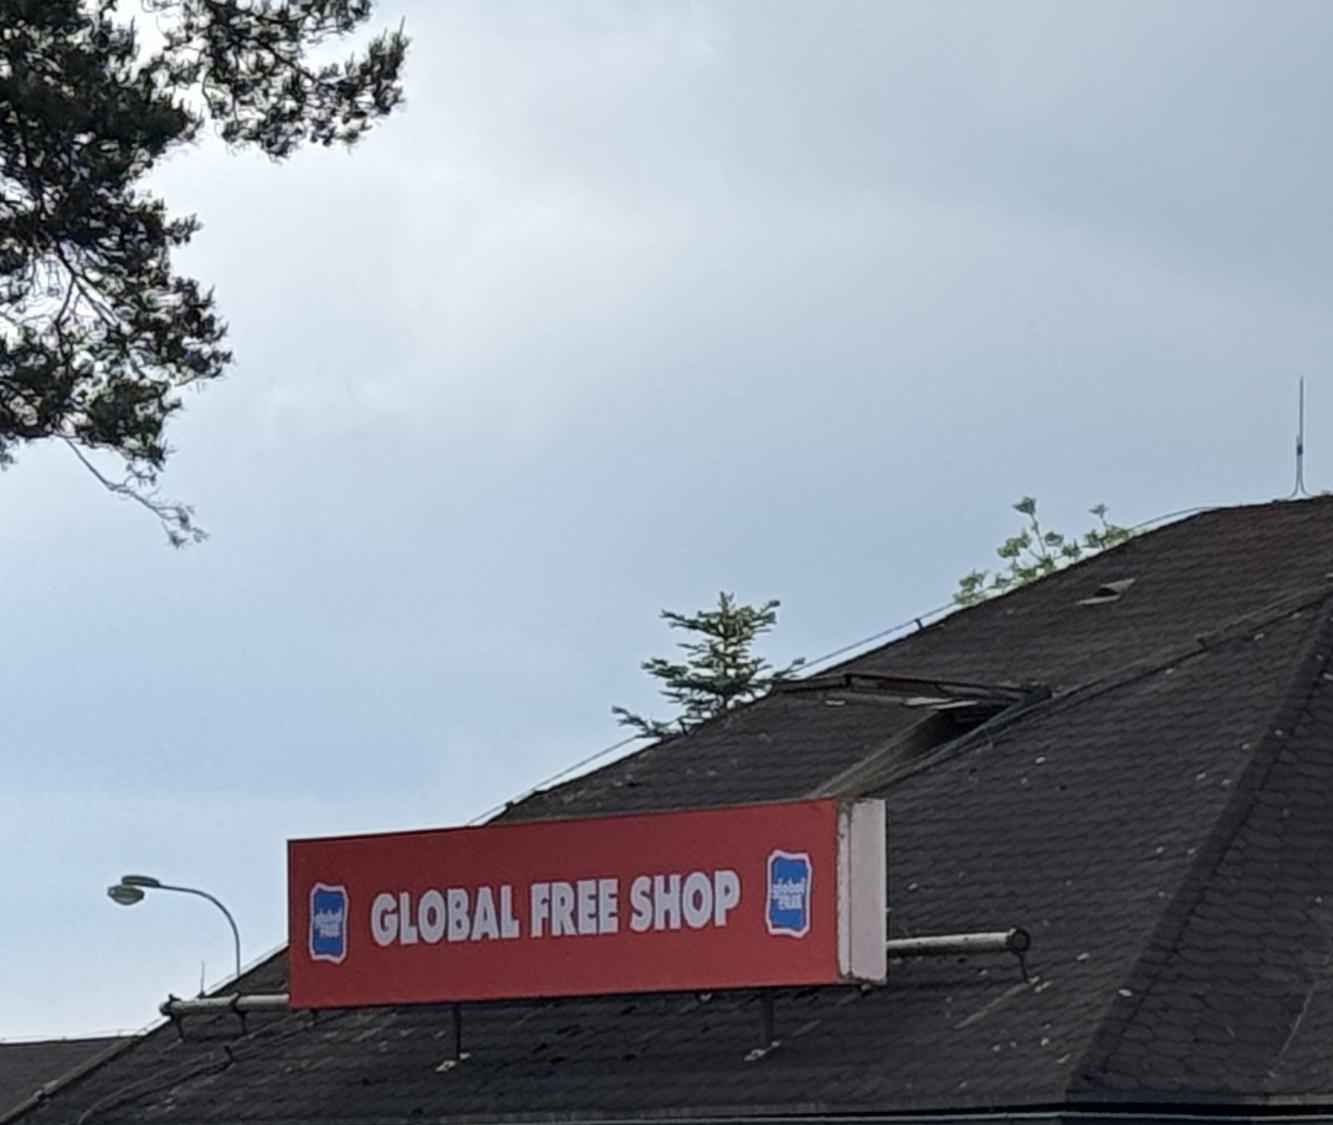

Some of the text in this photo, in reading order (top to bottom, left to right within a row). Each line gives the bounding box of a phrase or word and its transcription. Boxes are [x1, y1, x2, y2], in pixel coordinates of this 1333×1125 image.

[371, 870, 740, 946] GLOBAL FREE SHOP
